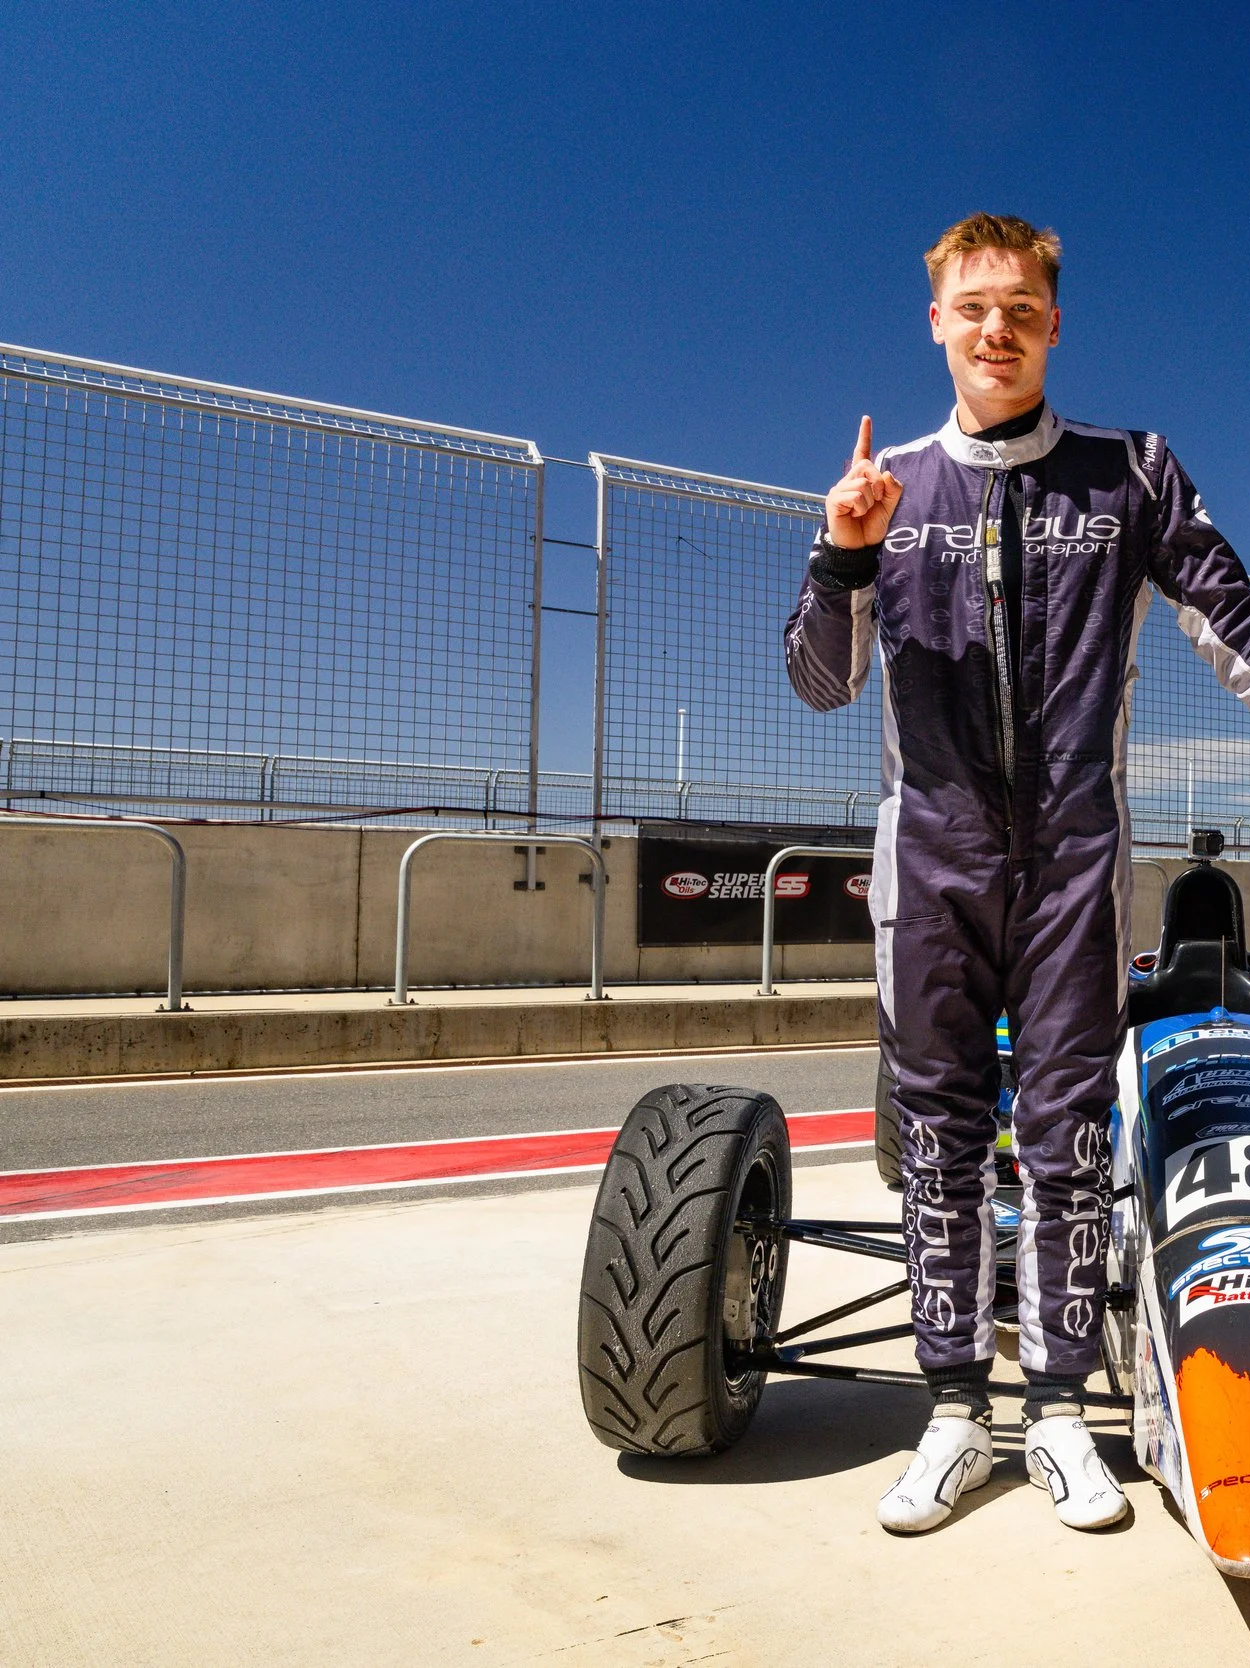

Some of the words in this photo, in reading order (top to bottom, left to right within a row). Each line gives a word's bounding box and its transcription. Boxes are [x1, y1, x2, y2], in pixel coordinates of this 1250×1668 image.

[884, 511, 1121, 554] erebus
[678, 876, 707, 887] Hi-Tec
[712, 873, 766, 886] SUPER
[858, 878, 872, 887] Hi-
[678, 885, 694, 894] Oils
[708, 885, 766, 898] SERIES
[857, 886, 869, 895] Oil
[909, 1120, 959, 1332] erebus
[1062, 1122, 1102, 1338] erebus
